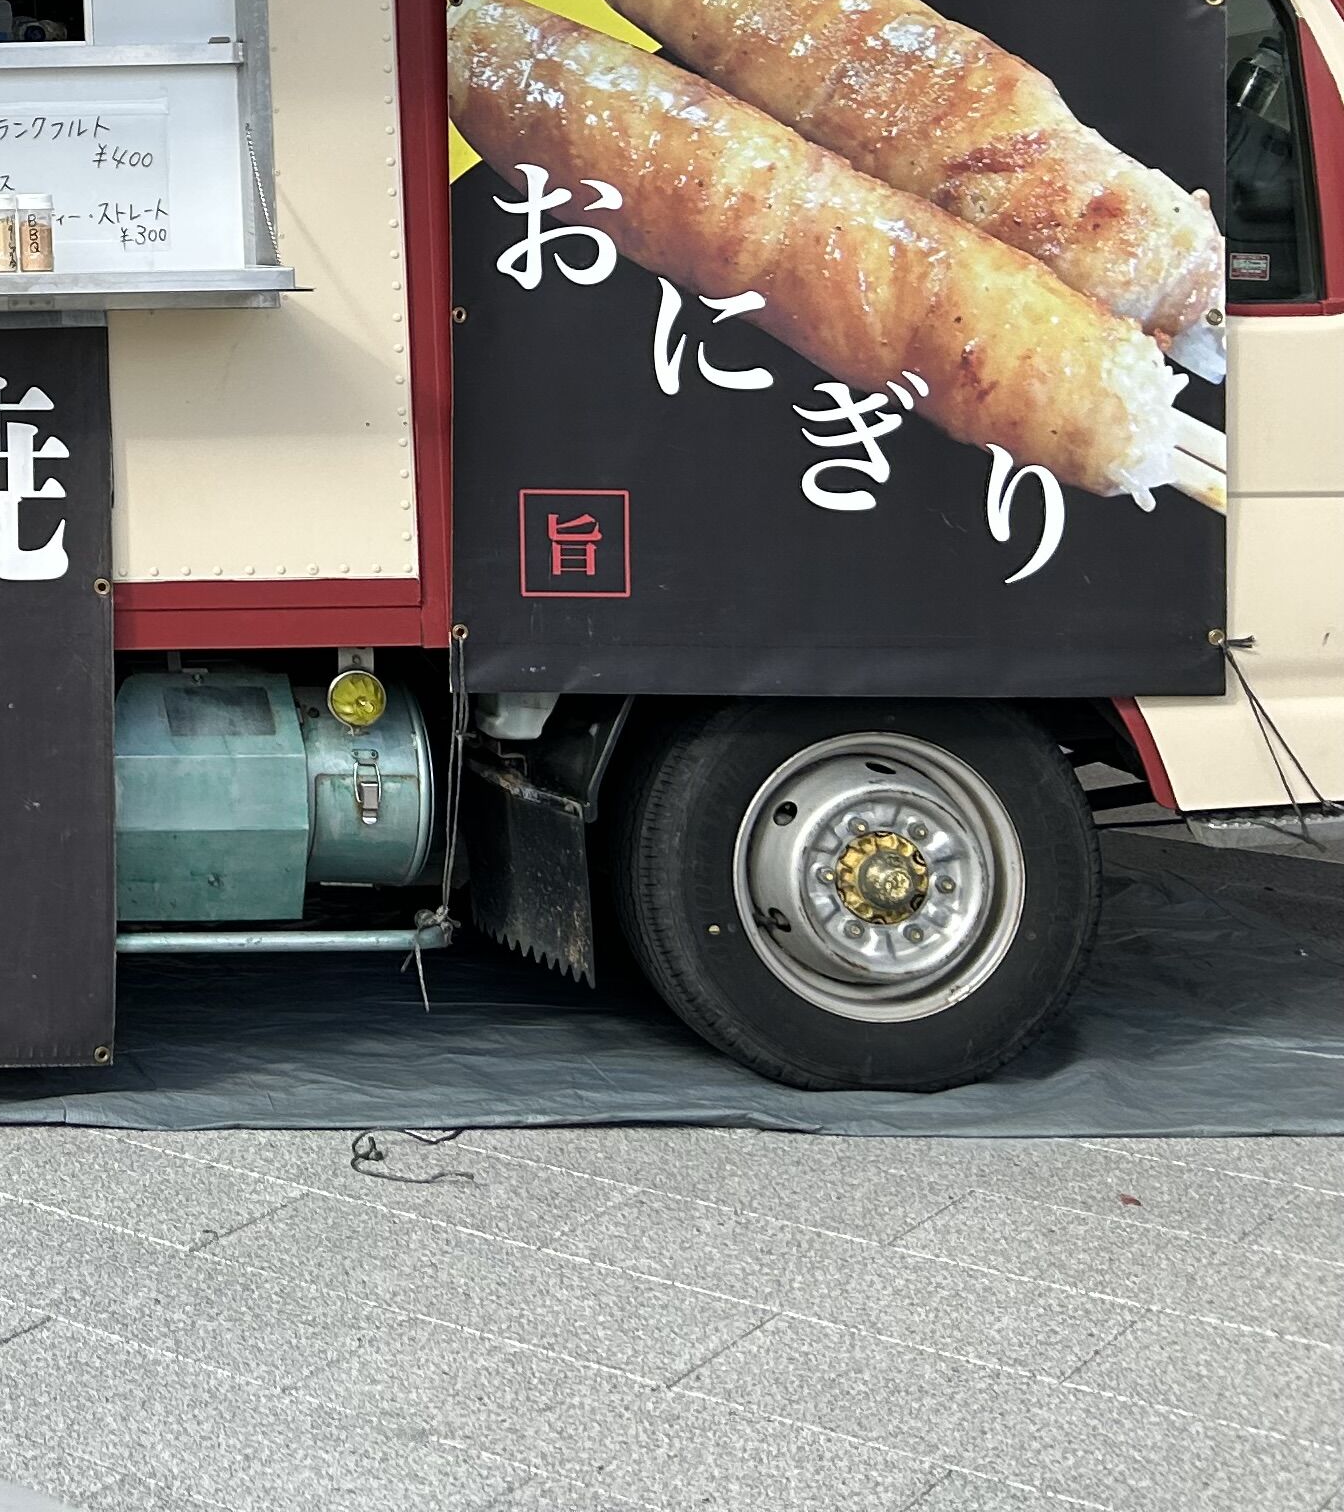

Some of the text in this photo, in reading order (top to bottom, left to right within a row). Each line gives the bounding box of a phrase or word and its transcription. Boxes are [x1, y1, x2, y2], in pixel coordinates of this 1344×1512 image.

[92, 143, 153, 169] ¥400
[27, 213, 41, 254] BBQ
[121, 225, 167, 246] ¥300
[547, 512, 603, 577] 旨
